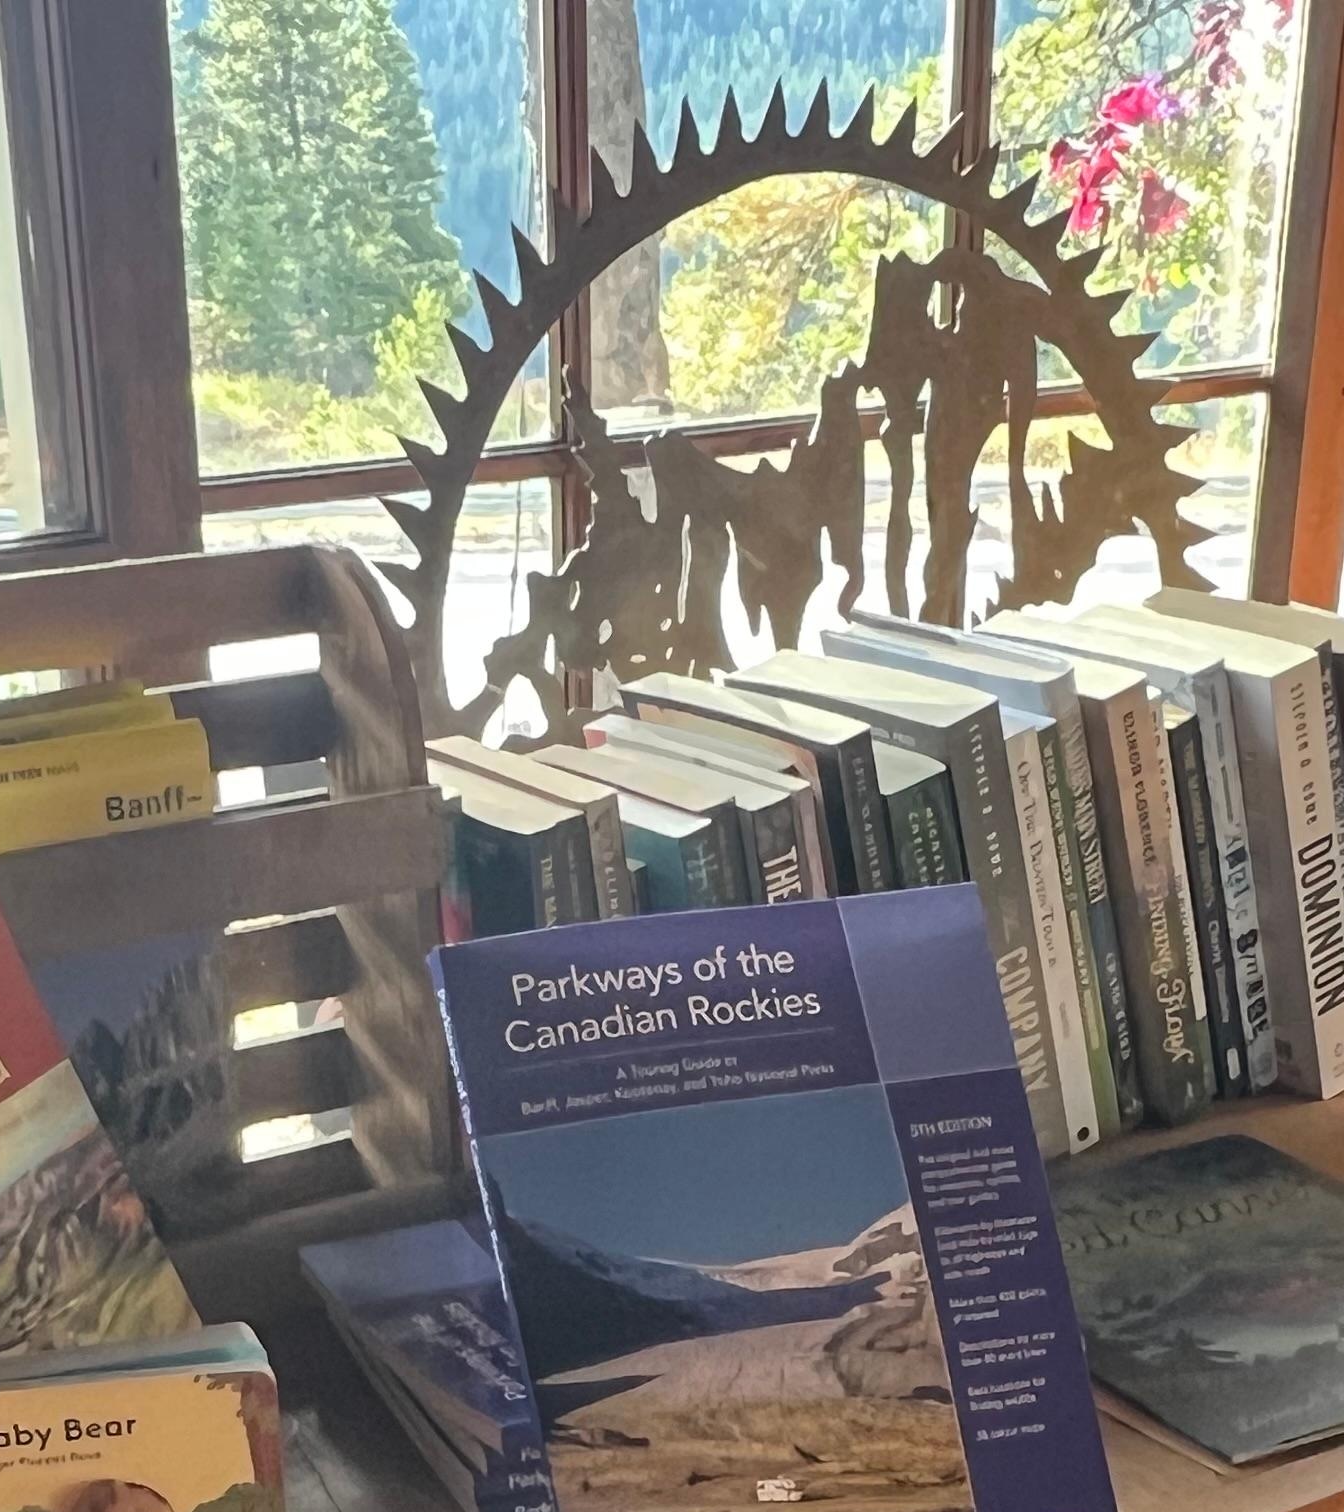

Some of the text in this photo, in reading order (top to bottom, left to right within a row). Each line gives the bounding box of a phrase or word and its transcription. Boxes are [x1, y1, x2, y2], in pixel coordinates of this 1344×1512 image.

[763, 845, 801, 905] THE
[510, 942, 796, 1007] Parkways of the
[504, 987, 822, 1053] Canadian Rockies
[996, 946, 1051, 1093] COMPANY
[64, 1418, 136, 1441] Bear
